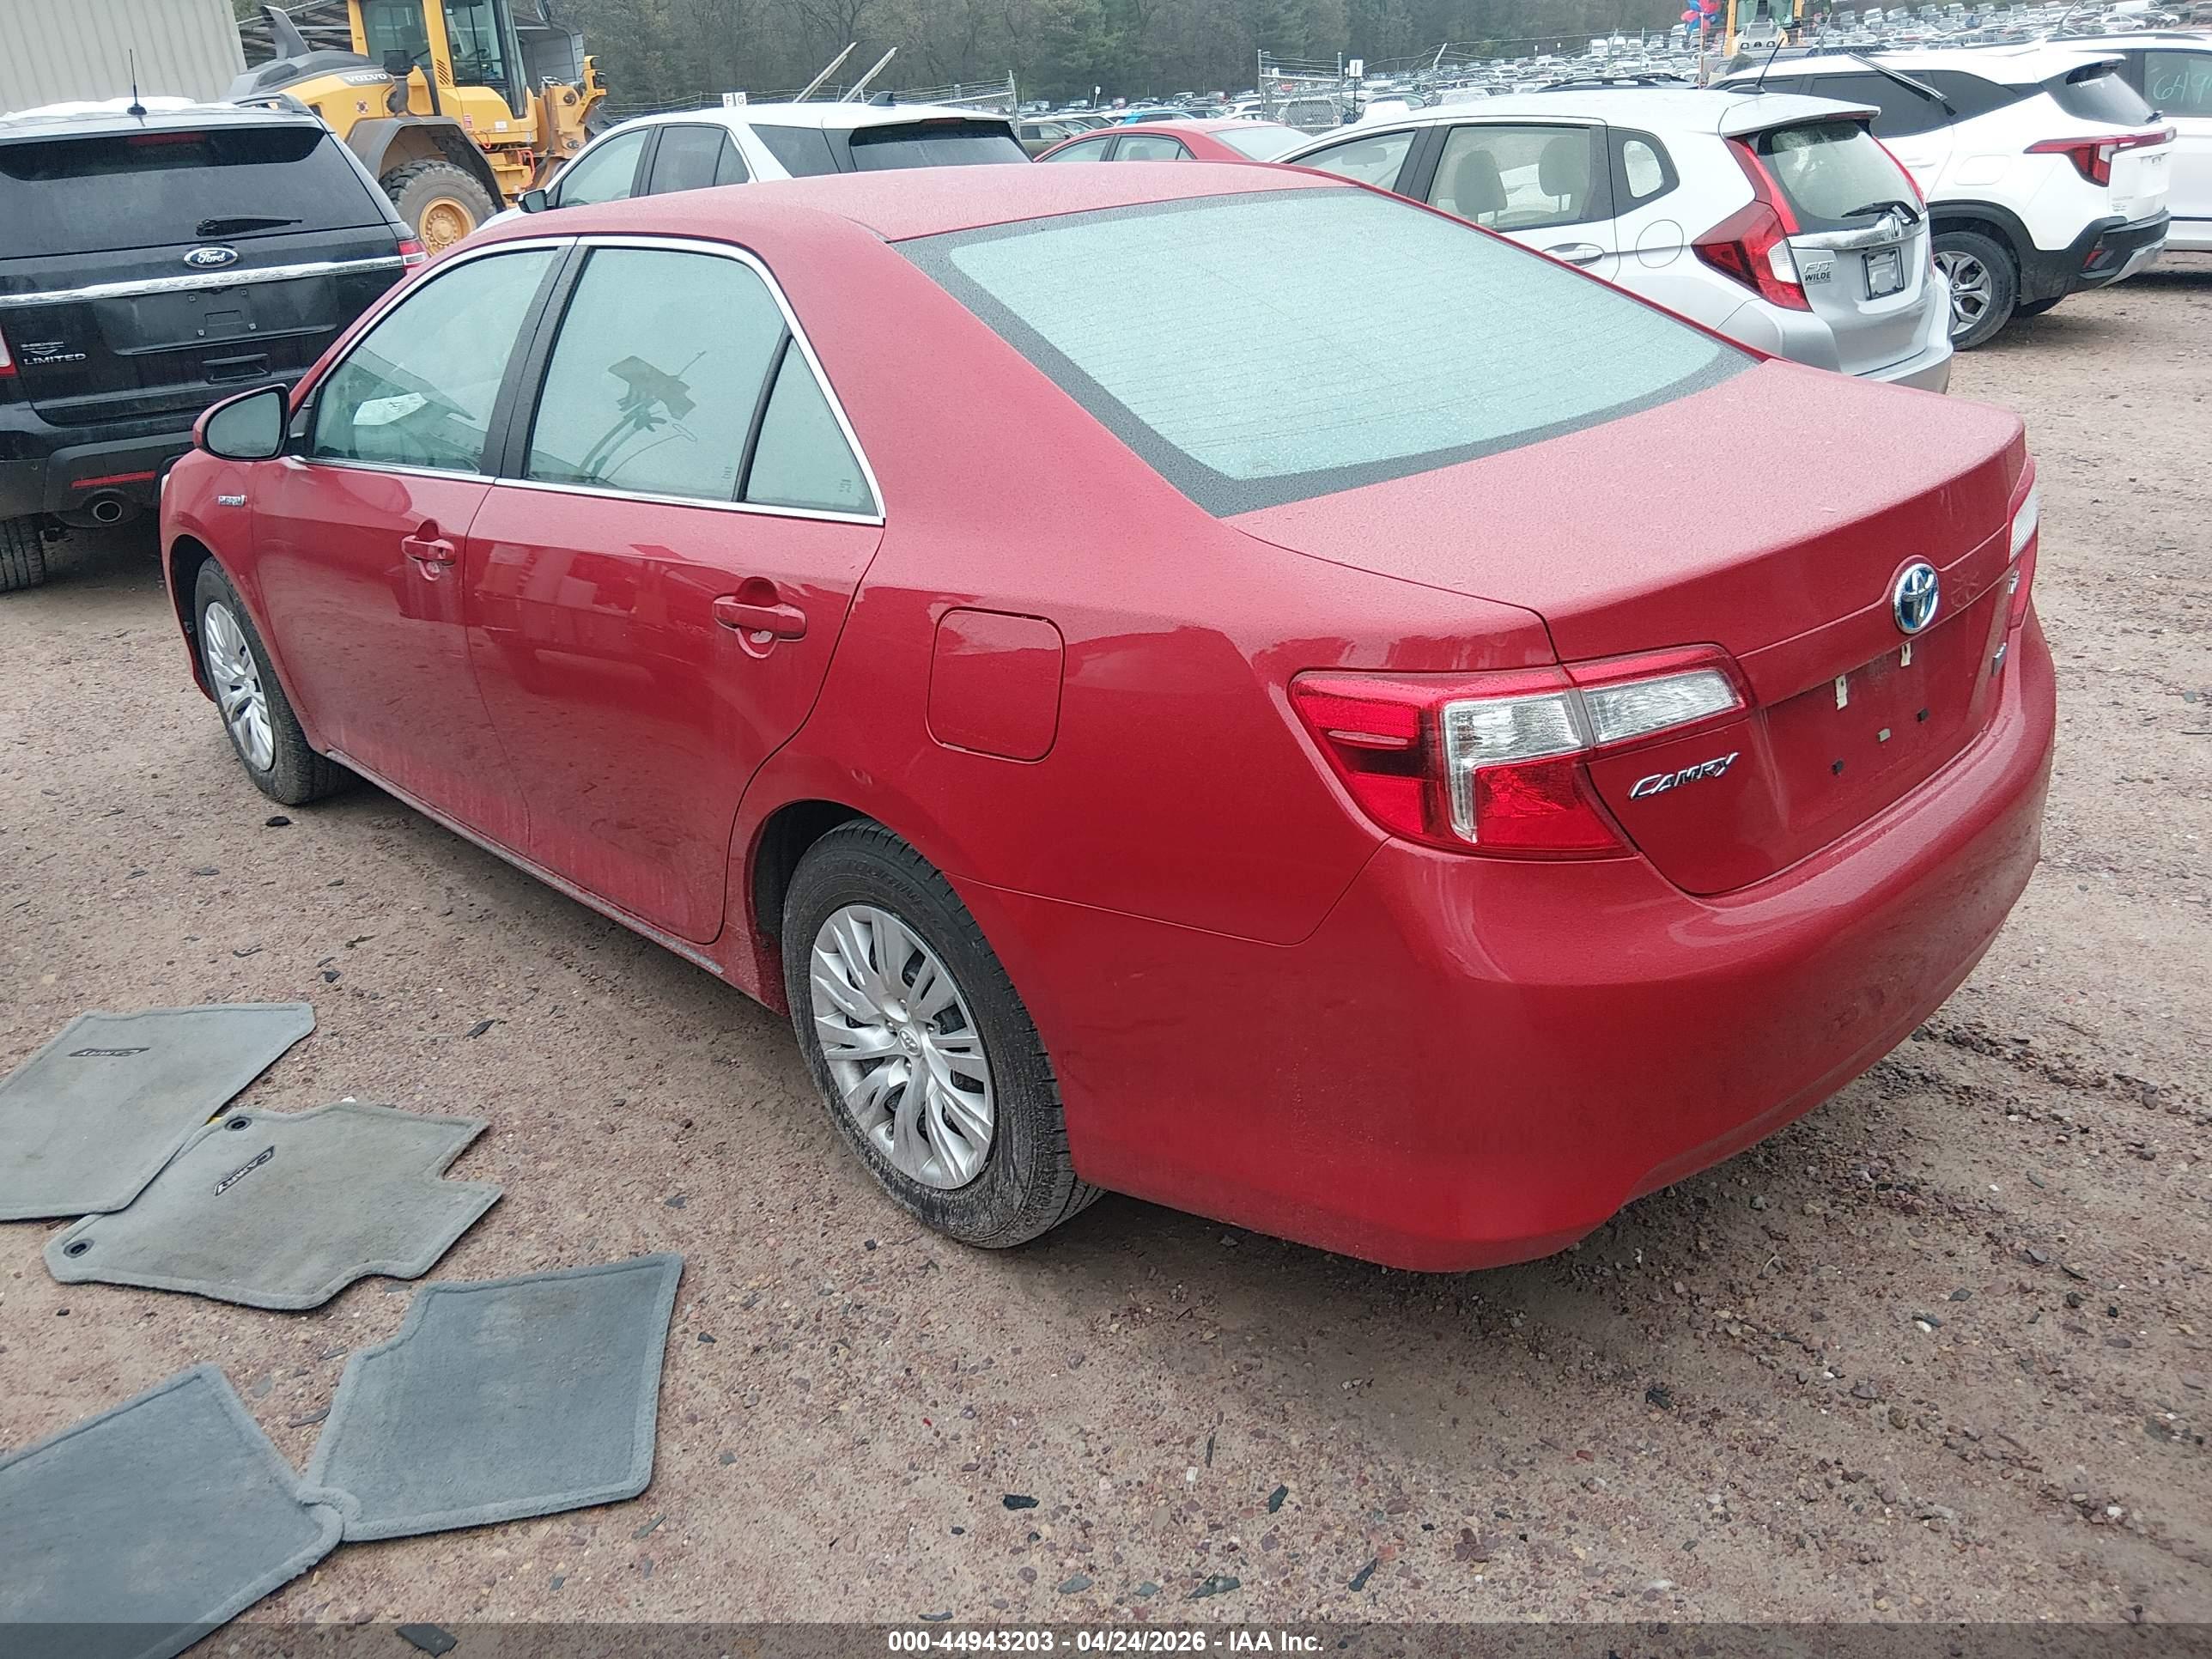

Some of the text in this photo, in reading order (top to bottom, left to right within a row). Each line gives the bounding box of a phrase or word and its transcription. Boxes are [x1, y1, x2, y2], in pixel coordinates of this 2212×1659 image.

[345, 73, 388, 82] VOLVO
[726, 95, 732, 106] F
[738, 94, 744, 105] G
[198, 250, 227, 264] Ford
[144, 270, 286, 290] EXPLORER
[1805, 271, 1832, 282] WILDE
[23, 353, 87, 365] LIMITED
[1629, 751, 1740, 800] CAMRY
[216, 1149, 273, 1194] CAMRY
